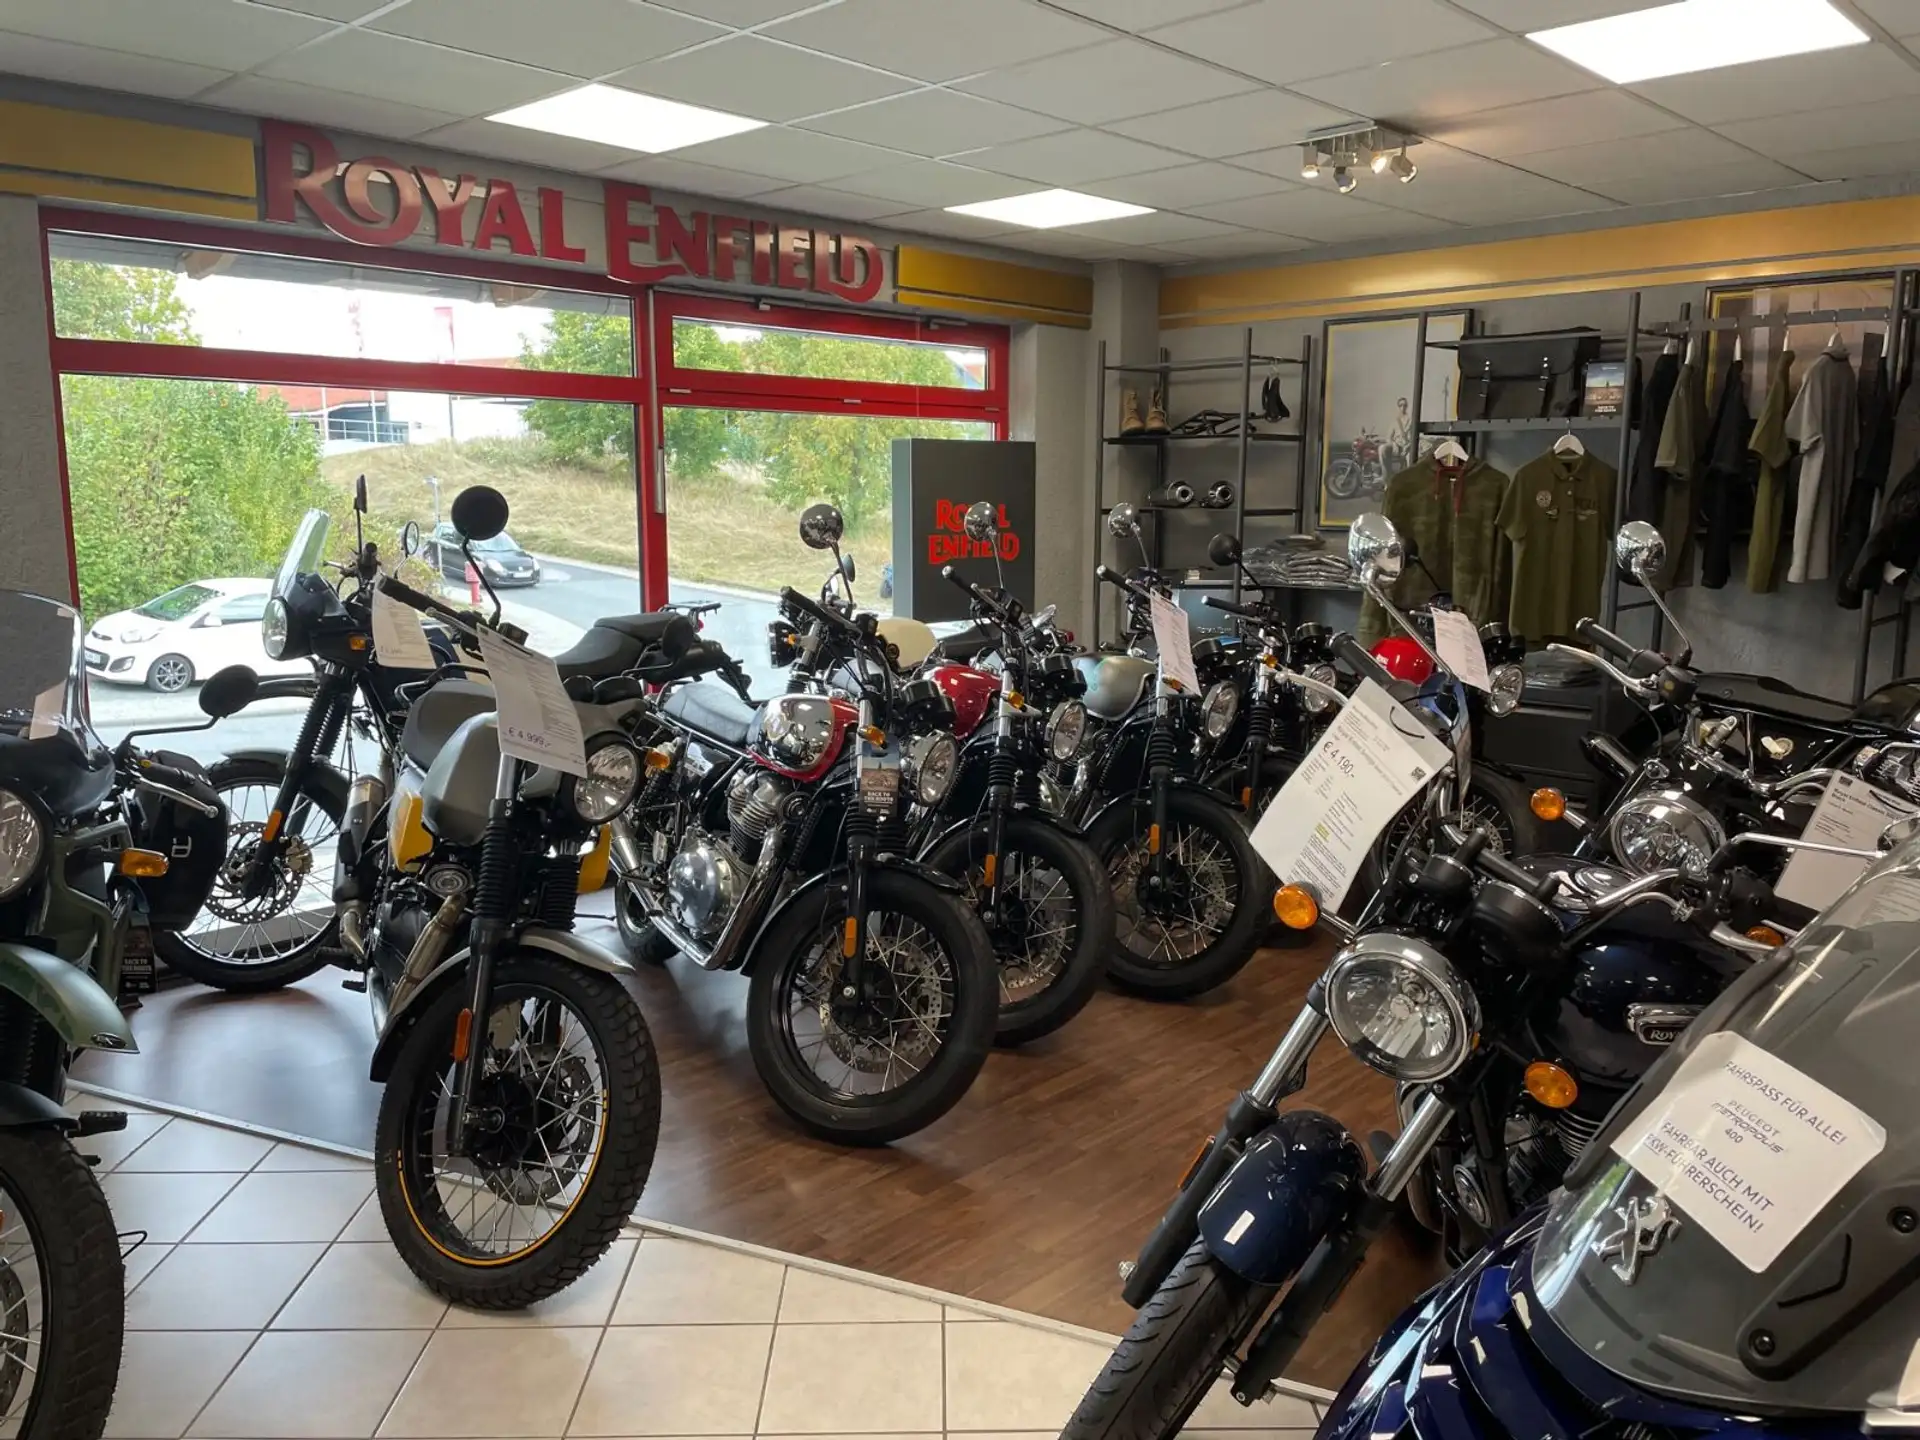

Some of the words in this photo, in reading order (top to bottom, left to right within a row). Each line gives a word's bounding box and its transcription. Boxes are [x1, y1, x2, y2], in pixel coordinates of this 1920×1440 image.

[262, 119, 586, 263] ROYAL
[604, 180, 884, 304] ENFIELD
[936, 499, 1011, 532] ROL
[1723, 1060, 1784, 1102] FAHRSPASS
[1780, 1096, 1808, 1121] FÜR
[1806, 1115, 1849, 1146] ALLE!
[1727, 1099, 1781, 1138] PEUGEOT
[1660, 1121, 1708, 1161] FAHRBAR
[1704, 1156, 1744, 1189] AUCH
[1741, 1185, 1775, 1212] MIT
[1724, 1127, 1744, 1145] 400
